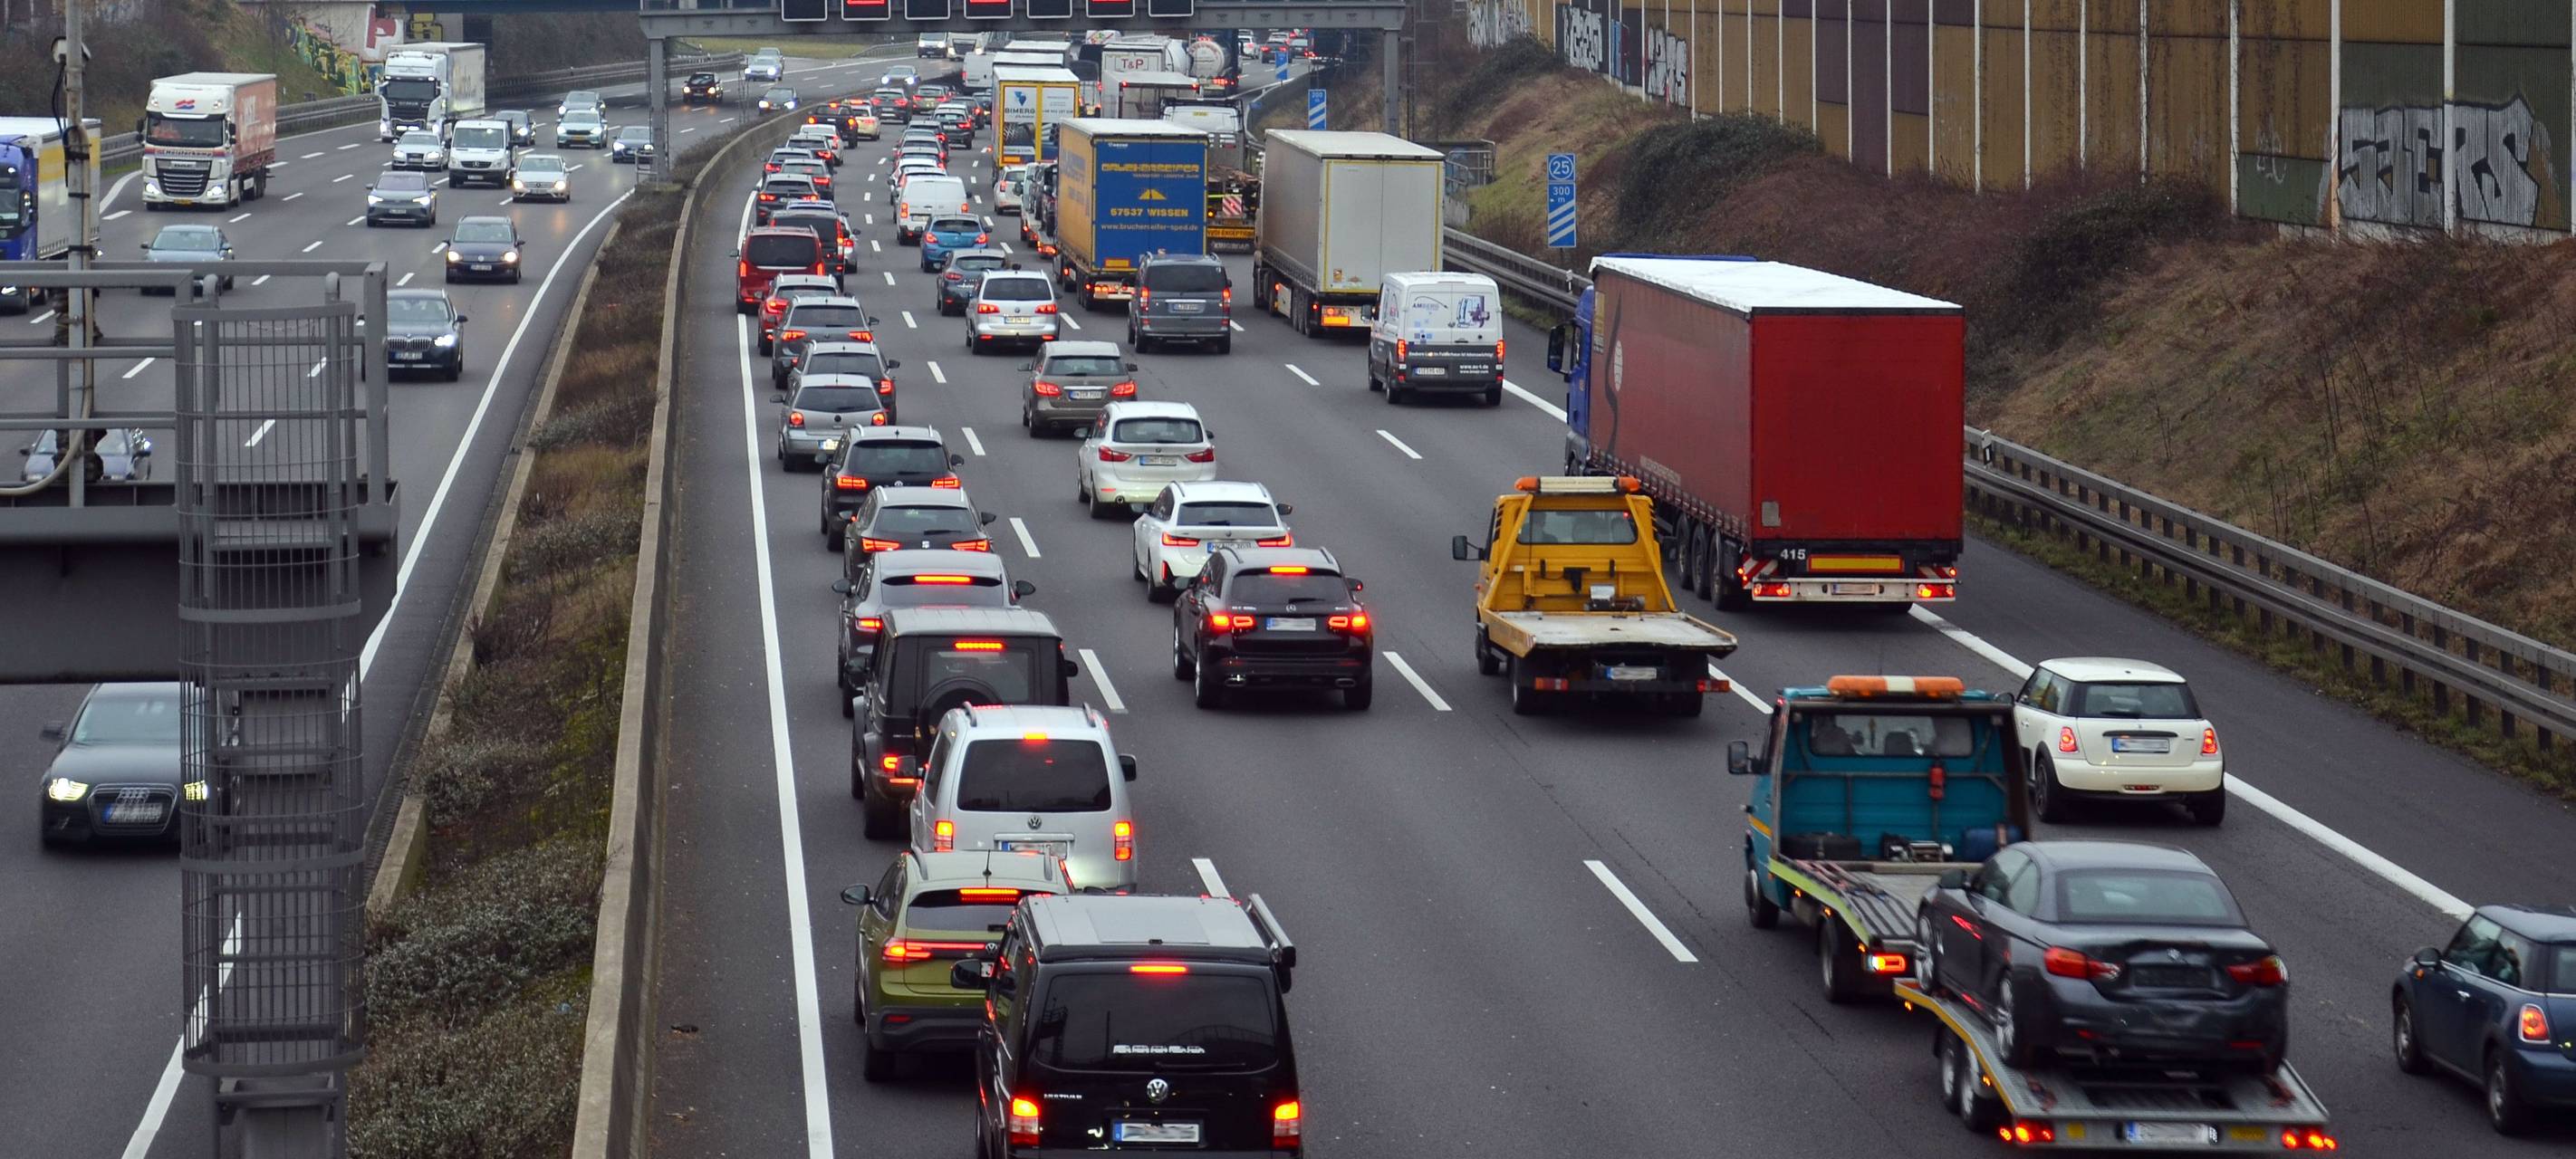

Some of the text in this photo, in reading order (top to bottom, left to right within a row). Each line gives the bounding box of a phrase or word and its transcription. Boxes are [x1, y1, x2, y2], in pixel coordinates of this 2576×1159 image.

[1121, 59, 1144, 70] T&P
[1552, 160, 1570, 174] 25
[1552, 187, 1570, 195] 300
[1147, 208, 1188, 217] WISSEN
[1780, 549, 1806, 560] 415
